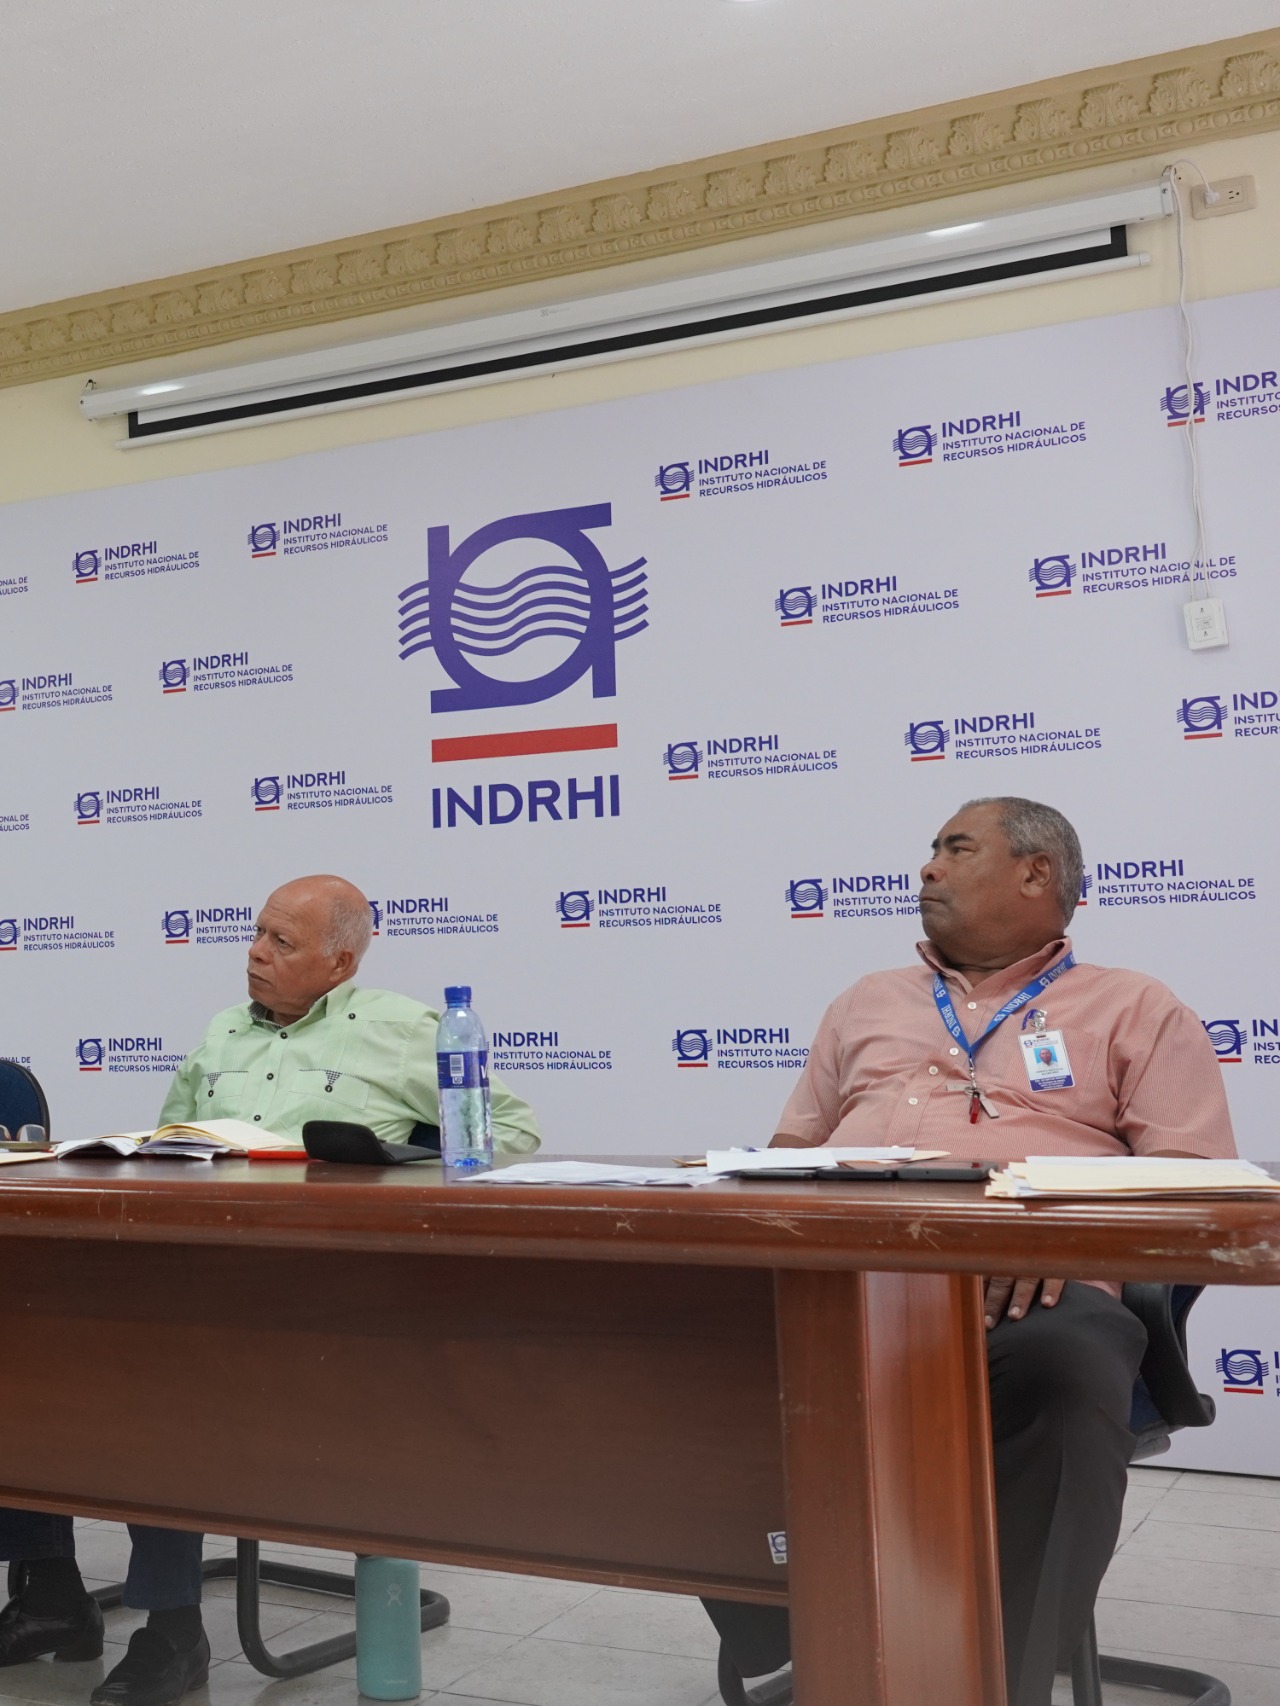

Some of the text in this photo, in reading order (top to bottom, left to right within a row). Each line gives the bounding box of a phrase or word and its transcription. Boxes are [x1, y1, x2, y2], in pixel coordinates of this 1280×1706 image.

[1215, 371, 1278, 395] INDR
[942, 410, 1020, 437] INDRHI
[943, 421, 1086, 450] INSTITUTO NACIONAL DE
[943, 433, 1087, 461] RECURSOS HIDRÁULICOS
[699, 449, 768, 474] INDRHI
[699, 460, 827, 486] INSTITUTO NACIONAL DE
[700, 471, 827, 497] RECURSOS HIDRÁULICOS
[284, 512, 340, 534] INDRHI
[284, 523, 387, 545] INSTITUTO NACIONAL DE
[105, 540, 156, 560] INDRHI
[284, 533, 387, 555] RECURSOS HIDRÁULICOS
[105, 551, 198, 571] INSTITUTO NACIONAL DE
[1081, 542, 1165, 568] INDRHI
[105, 568, 145, 580] RECURSOS
[1082, 556, 1235, 581] INSTITUTO DE
[822, 575, 897, 599] INDRHI
[1083, 578, 1148, 593] RECURSOS
[823, 588, 959, 612] INSTITUTO NACIONAL DE
[823, 600, 959, 623] RECURSOS HIDRÁULICOS
[193, 651, 248, 670] INDRHI
[194, 663, 292, 681] INSTITUTO NACIONAL DE
[22, 672, 71, 690] INDRHI
[194, 680, 236, 691] RECURSOS
[22, 684, 112, 701] INSTITUTO NACIONAL DE
[22, 699, 61, 710] RECURSOS
[954, 712, 1034, 734] INDRHI
[707, 734, 778, 755] INDRHI
[955, 728, 1100, 747] INSTITUTO NACIONAL DE
[956, 740, 1101, 759] RECURSOS HIDRÁULICOS
[708, 750, 837, 768] INSTITUTO NACIONAL DE
[708, 761, 838, 778] RECURSOS HIDRÁULICOS
[287, 770, 345, 788] INDRHI
[107, 786, 159, 803] INDRHI
[288, 784, 392, 800] INSTITUTO NACIONAL DE
[107, 804, 146, 814] INSTITUTO
[149, 801, 189, 811] NACIONAL
[288, 795, 393, 810] RECURSOS HIDRÁULICOS
[432, 774, 620, 829] INDRHI
[107, 814, 147, 823] RECURSOS
[1097, 859, 1183, 880] INDRHI
[833, 874, 908, 893] INDRHI
[1098, 878, 1254, 894] INSTITUTO NACIONAL DE
[598, 886, 665, 904] INDRHI
[834, 895, 891, 906] INSTITUTO
[1099, 890, 1255, 906] RECURSOS HIDRÁULICOS
[387, 897, 447, 914] INDRHI
[599, 903, 722, 917] INSTITUTO NACIONAL DE
[834, 907, 893, 917] RECURSOS
[24, 916, 73, 930] INDRHI
[196, 907, 251, 922] INDRHI
[387, 913, 498, 926] INSTITUTO NACIONAL DE
[599, 914, 722, 927] RECURSOS HIDRÁULICOS
[24, 933, 62, 941] INSTITUTO
[64, 931, 103, 939] NACIONAL
[197, 925, 238, 934] INSTITUTO
[387, 923, 498, 936] RECURSOS HIDRÁULICOS
[24, 942, 62, 950] RECURSOS
[197, 935, 239, 943] RECURSOS
[1002, 992, 1032, 1013] INDRHI
[109, 1037, 161, 1051] INDRHI
[493, 1032, 557, 1047] INDRHI
[717, 1028, 789, 1044] INDRHI
[494, 1050, 611, 1059] INSTITUTO NACIONAL DE
[717, 1048, 772, 1057] INSTITUTO
[494, 1060, 611, 1070] RECURSOS HIDRÁULICOS
[718, 1060, 774, 1068] RECURSOS
